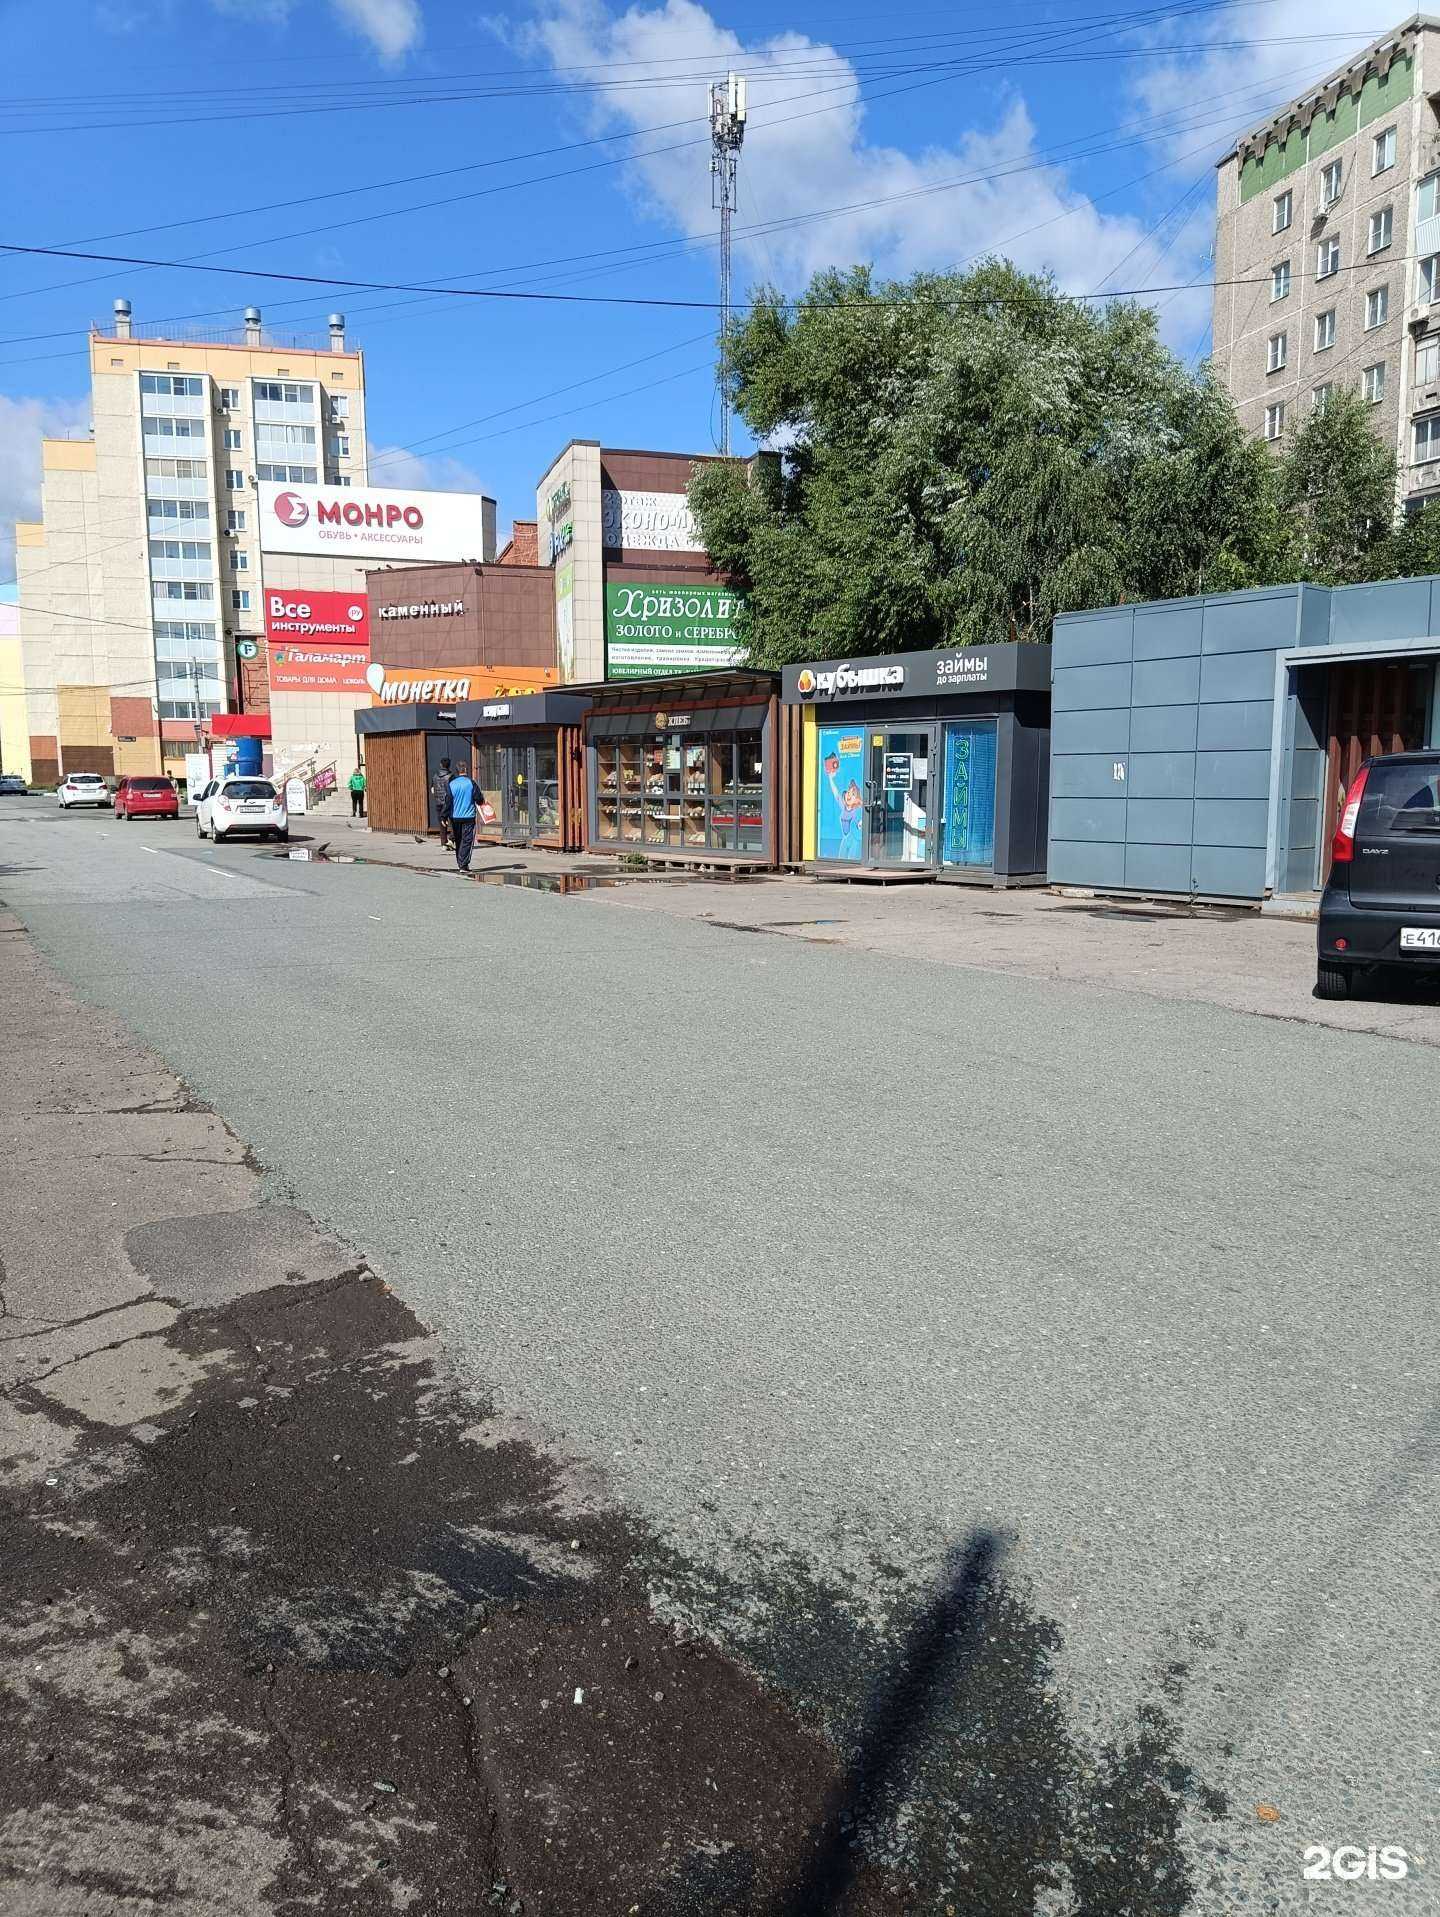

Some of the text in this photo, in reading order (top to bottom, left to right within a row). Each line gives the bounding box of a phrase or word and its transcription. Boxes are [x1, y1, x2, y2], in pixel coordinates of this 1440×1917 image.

[317, 500, 424, 529] МОНРО
[318, 530, 423, 545] ОБУВЬ АКСЕССУАРЫ
[270, 596, 311, 618] Все
[378, 599, 464, 618] каменный
[271, 621, 356, 635] инструменты
[616, 624, 672, 638] ЗОЛОТО
[286, 649, 366, 667] Галамарт
[936, 652, 987, 674] займы
[317, 677, 337, 685] ДОМА
[936, 673, 987, 686] до зарплаты
[951, 739, 969, 849] ЗАЙМЫ
[1362, 847, 1390, 855] DAYZ
